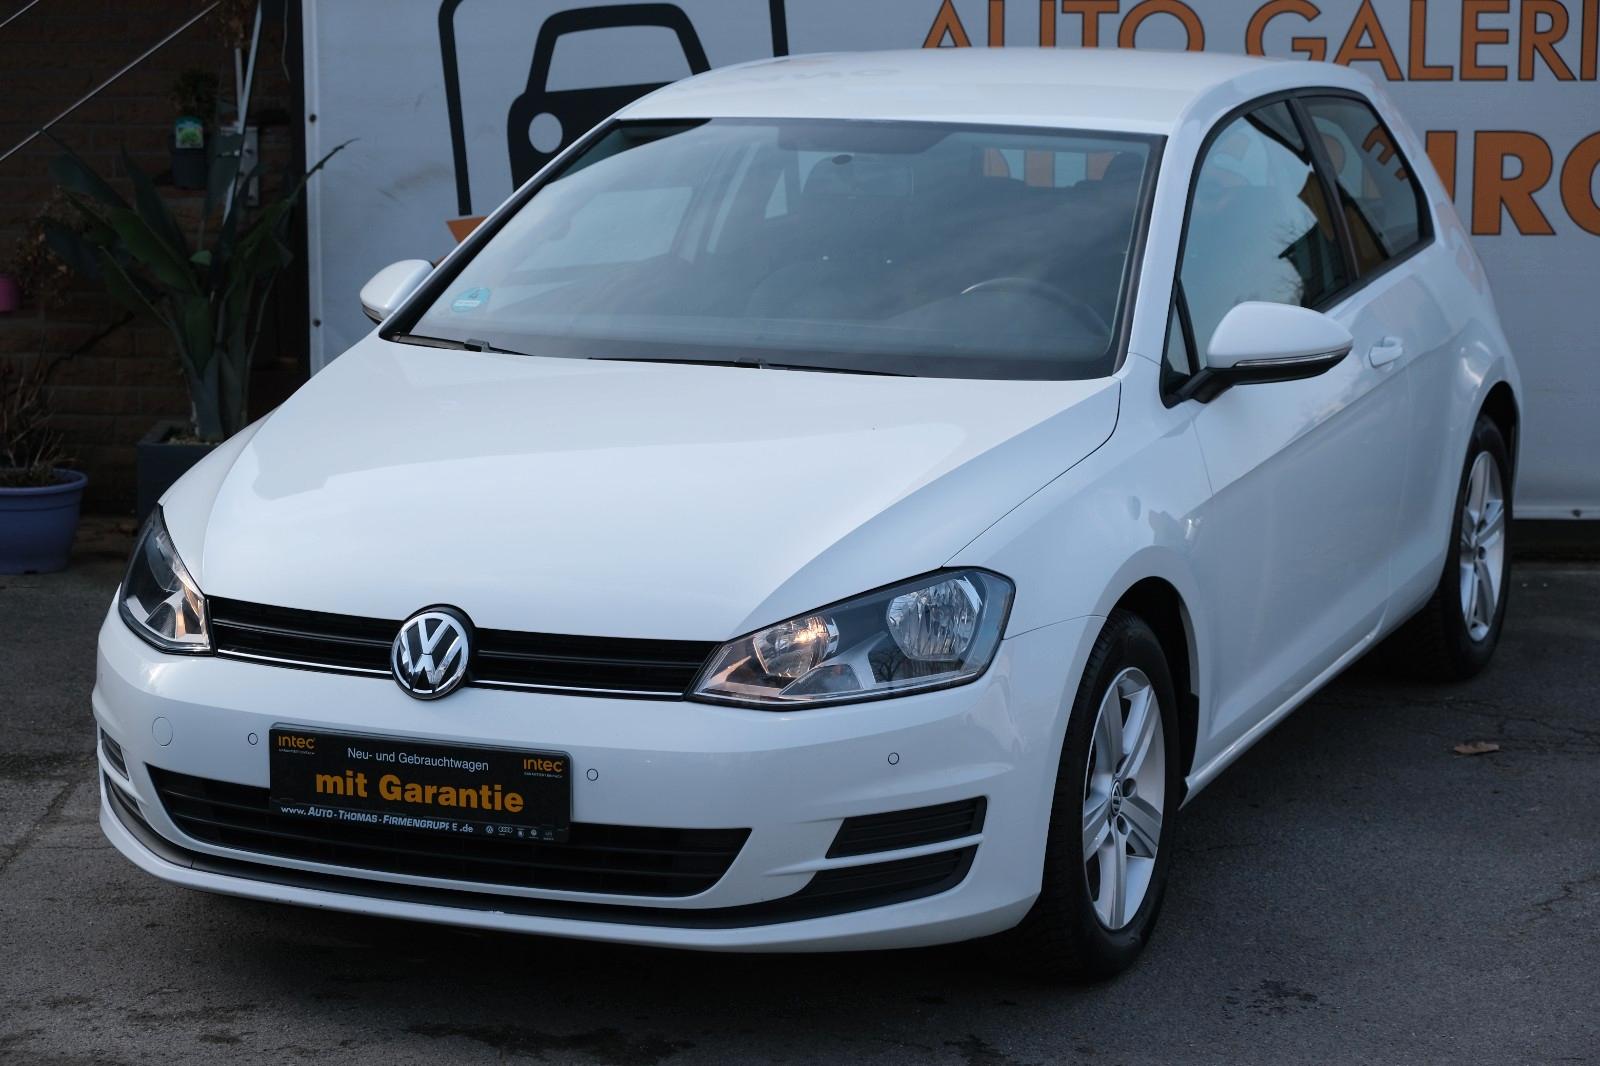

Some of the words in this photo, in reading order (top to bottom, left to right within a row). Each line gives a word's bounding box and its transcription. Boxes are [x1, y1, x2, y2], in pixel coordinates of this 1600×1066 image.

[921, 0, 1205, 51] AUTO
[1245, 0, 1599, 81] GALERI
[278, 735, 315, 750] intec
[347, 747, 373, 760] Neu-
[375, 751, 396, 763] und
[398, 752, 489, 773] Gebrauchtwagen
[523, 758, 563, 773] intec
[315, 769, 368, 798] mit
[378, 773, 525, 813] Garantie
